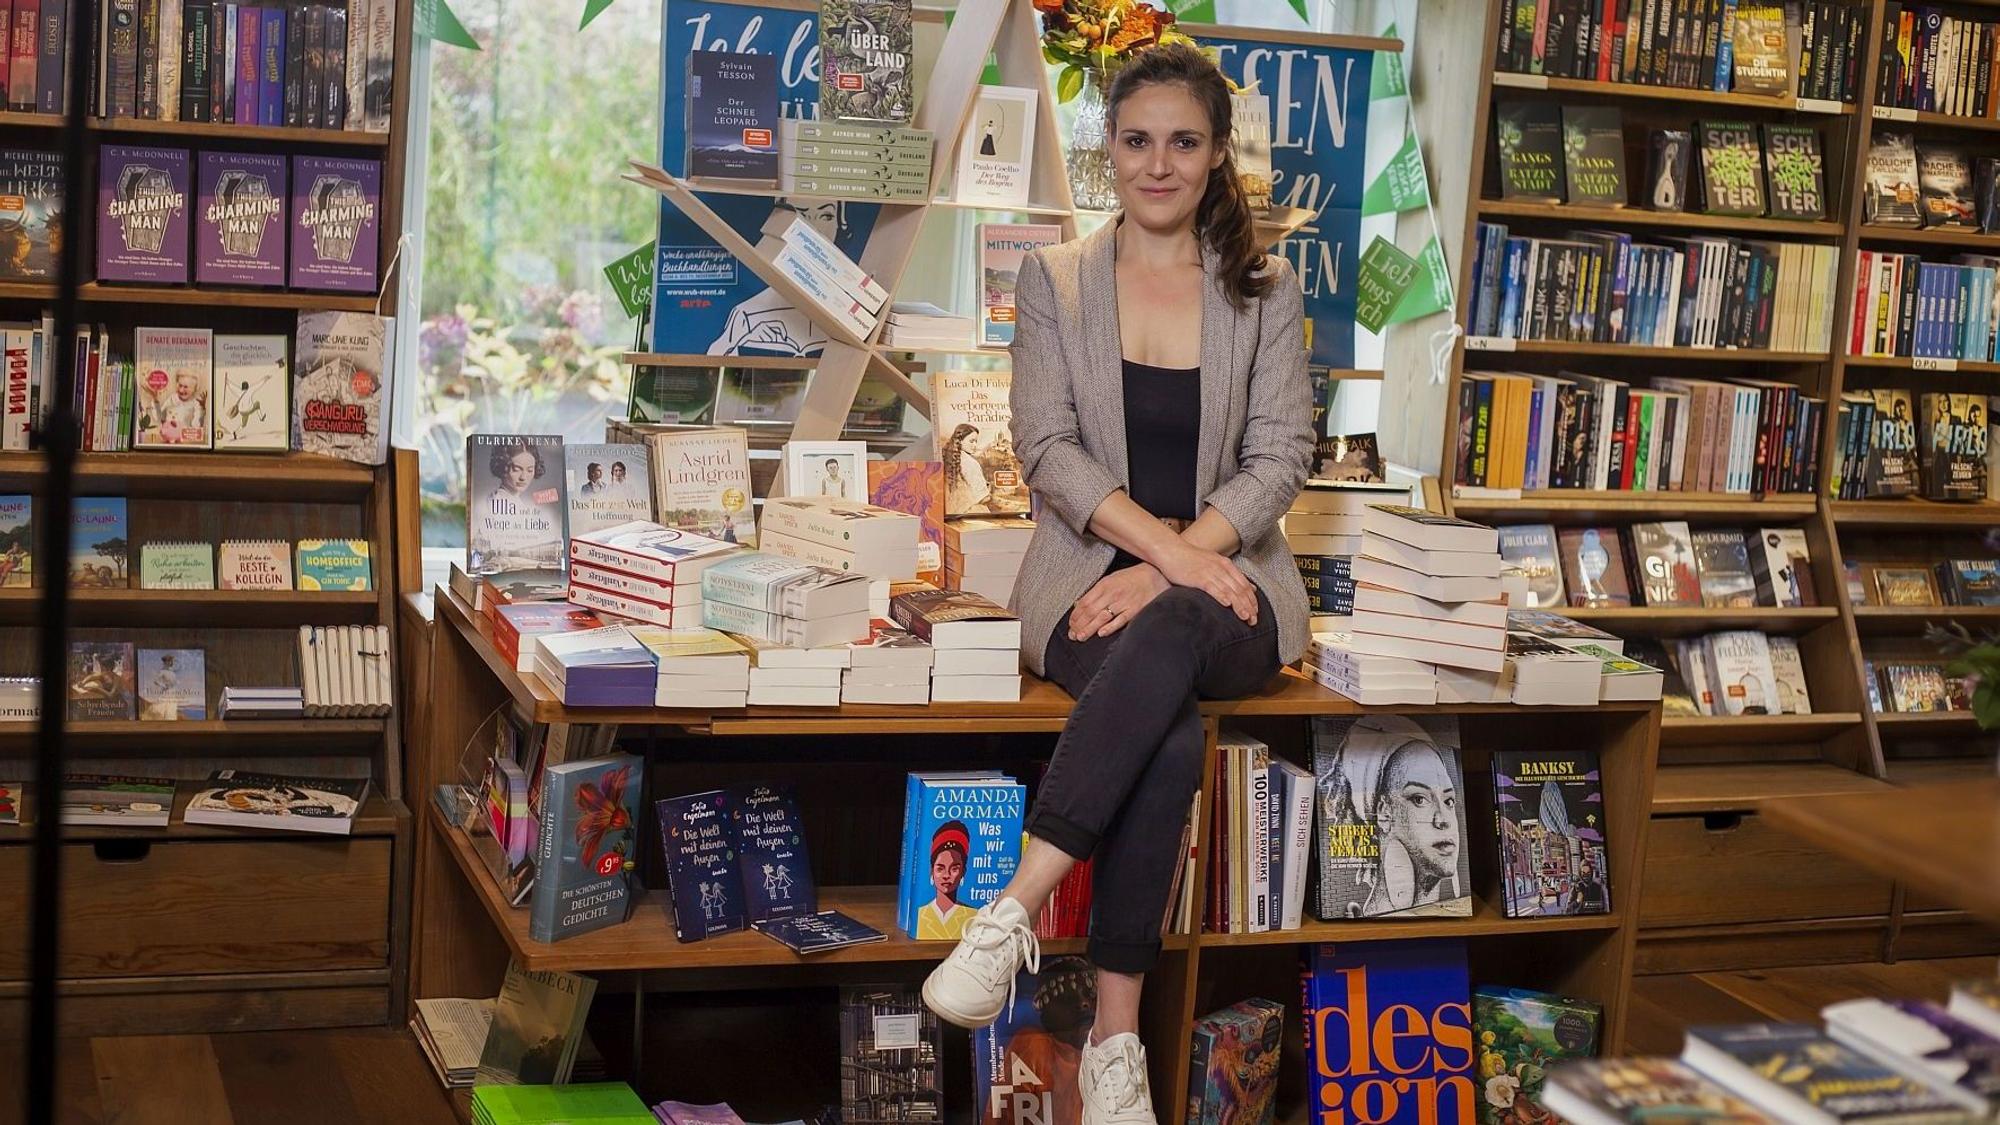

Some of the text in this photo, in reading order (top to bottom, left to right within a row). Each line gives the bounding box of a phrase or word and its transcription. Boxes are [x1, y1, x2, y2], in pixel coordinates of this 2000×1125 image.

[851, 30, 890, 50] ÜBER
[1578, 14, 1590, 56] FITZEK
[1592, 24, 1602, 53] FITZEK
[720, 61, 752, 71] Sylvain
[866, 52, 906, 68] LAND
[718, 72, 755, 80] TESSON
[1736, 66, 1786, 78] STUDENTIN
[728, 98, 744, 106] Der
[716, 107, 756, 117] SCHNEE
[714, 117, 758, 127] LEOPARD
[1708, 130, 1750, 149] SCH
[1772, 134, 1812, 154] SCH
[109, 193, 183, 216] CHARMING
[1713, 186, 1756, 209] TER
[1776, 191, 1818, 212] TER
[208, 198, 280, 220] CHARMING
[302, 204, 374, 225] CHARMING
[130, 215, 161, 230] MAN
[228, 220, 258, 234] MAN
[322, 224, 352, 238] MAN
[662, 260, 732, 275] Buchhandlungen
[1370, 236, 1413, 288] Lieb
[666, 288, 726, 296] www.wub-event.de
[172, 336, 208, 346] BERGMANN
[348, 336, 369, 346] KLING
[944, 379, 967, 388] Luca
[972, 391, 988, 400] Das
[478, 436, 558, 445] ULRIKE RENK
[680, 449, 731, 467] Astrid
[668, 466, 745, 486] Lindgren
[492, 499, 516, 515] Ulla
[572, 500, 589, 509] Das
[626, 500, 648, 510] Welt
[484, 518, 550, 531] Wege Liebe
[1503, 534, 1548, 546] JULIE CLARK
[240, 562, 268, 572] BESTE
[236, 573, 283, 584] KOLLEGIN
[1520, 762, 1575, 776] BANKSY
[935, 789, 1021, 803] AMANDA
[745, 810, 785, 824] Die Welt
[933, 804, 1020, 819] GORMAN
[978, 822, 1002, 836] Was
[1254, 774, 1268, 883] 100 MEISTERWERKE
[1297, 796, 1310, 848] SICH SEHEN
[544, 812, 554, 858] GEDICHTE
[683, 824, 720, 840] Die Welt
[742, 824, 792, 838] mit deinen
[680, 840, 728, 854] mit deinen
[756, 838, 786, 852] Augen
[986, 838, 1004, 852] wir
[1330, 846, 1379, 857] FEMALE
[693, 854, 720, 868] Augen
[973, 854, 992, 868] mit
[978, 873, 998, 884] uns
[562, 890, 573, 899] DIE
[571, 888, 624, 910] DEUTSCHEN
[970, 887, 1003, 903] trage
[563, 905, 608, 926] GEDICHTE
[1317, 964, 1473, 1078] des
